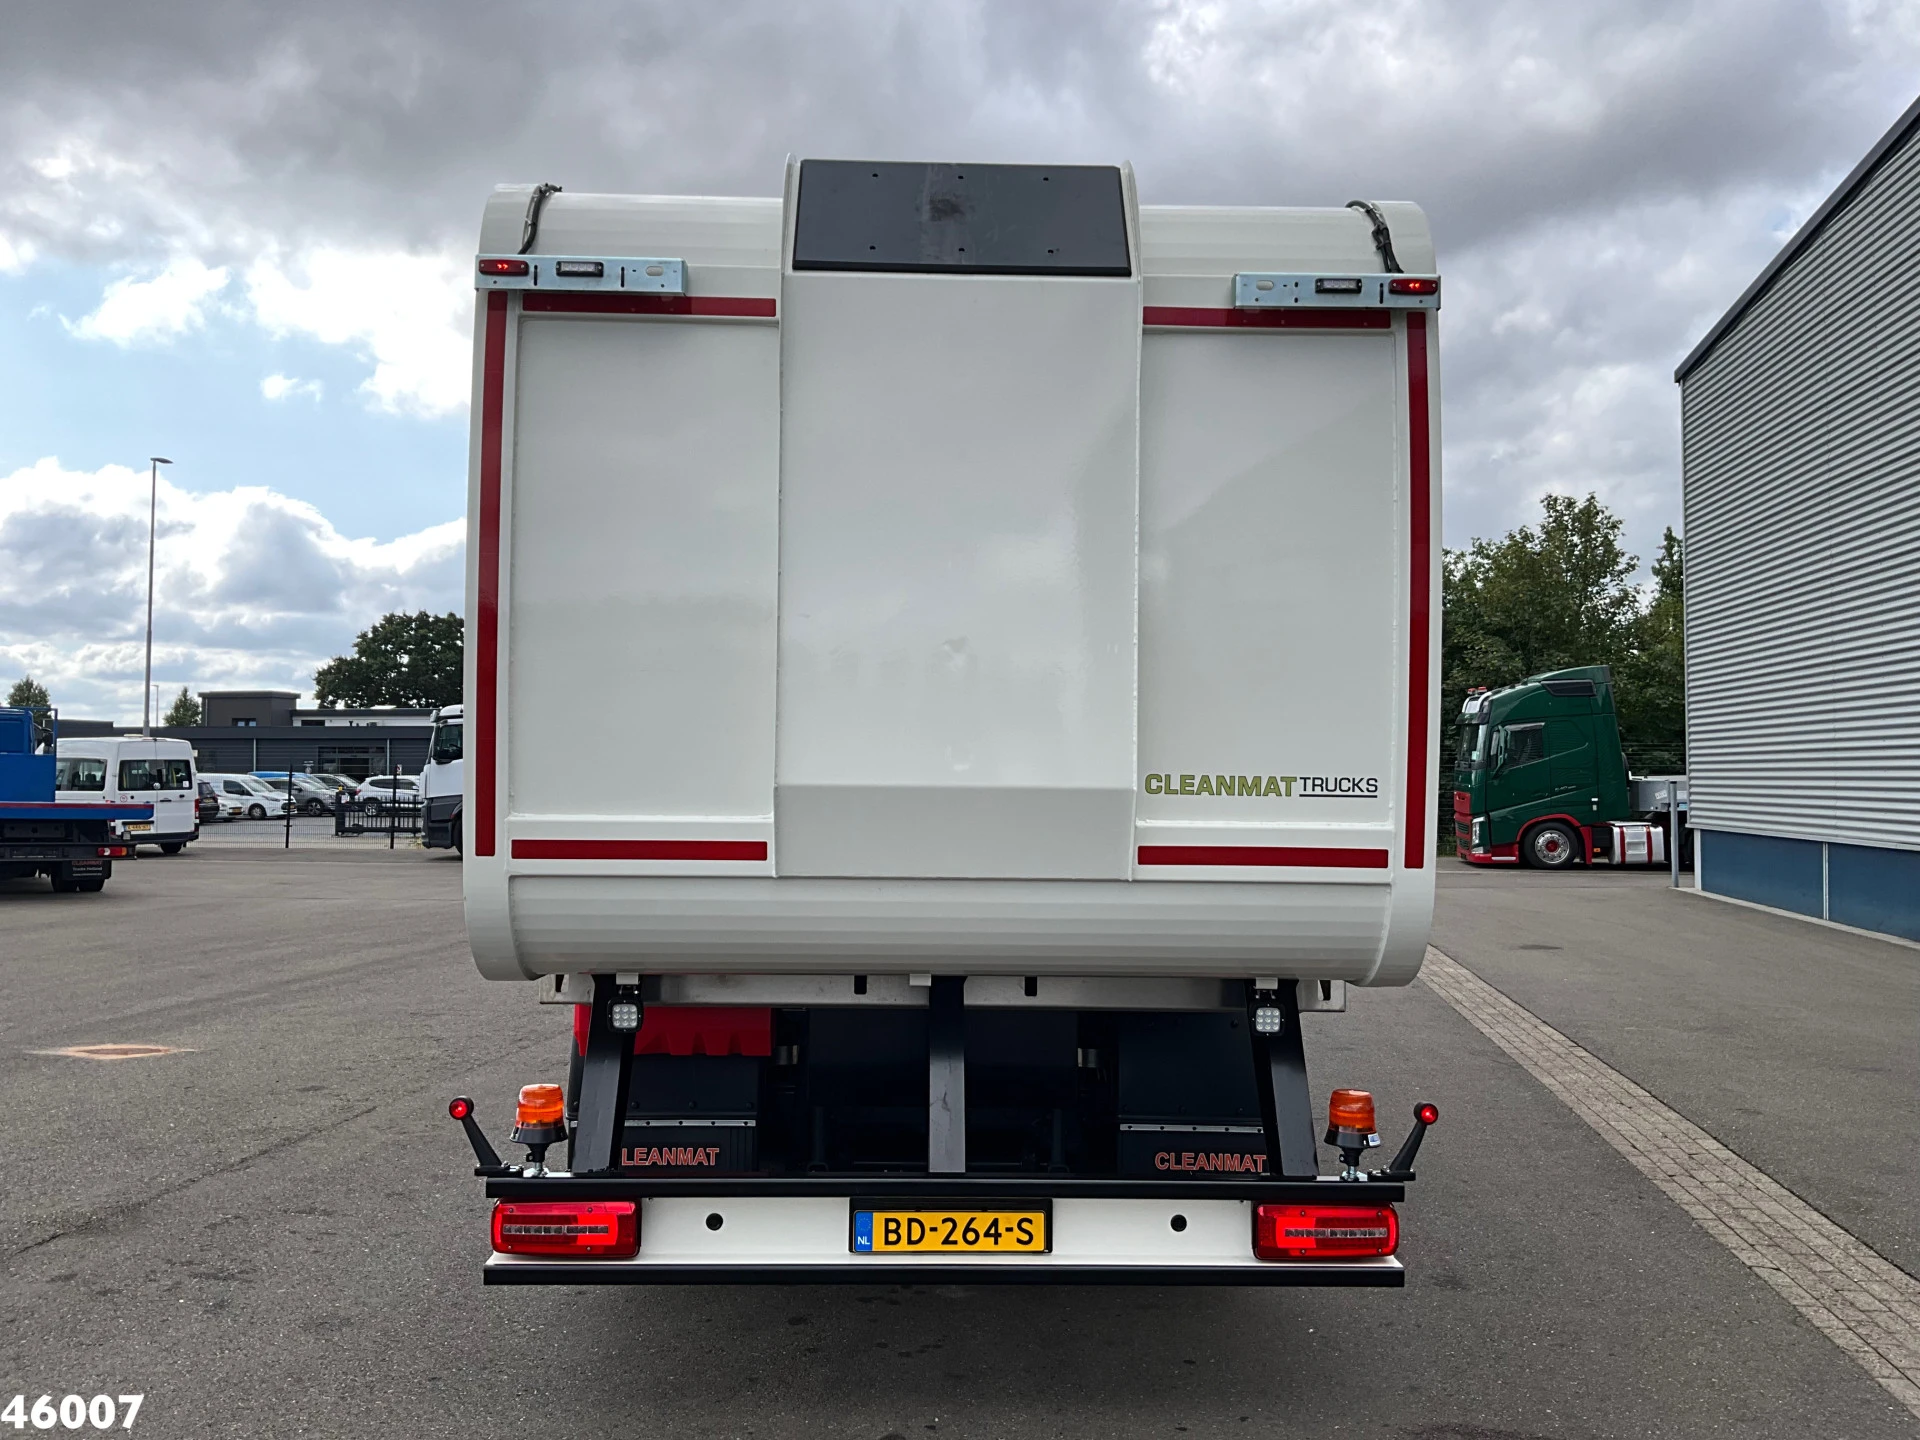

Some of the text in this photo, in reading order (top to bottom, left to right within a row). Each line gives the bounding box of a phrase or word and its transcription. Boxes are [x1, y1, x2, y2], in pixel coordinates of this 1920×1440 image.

[621, 1147, 719, 1166] LEANMAT
[1154, 1152, 1267, 1172] CLEANMAT
[857, 1236, 871, 1245] NL
[883, 1217, 1034, 1246] BD-264-S
